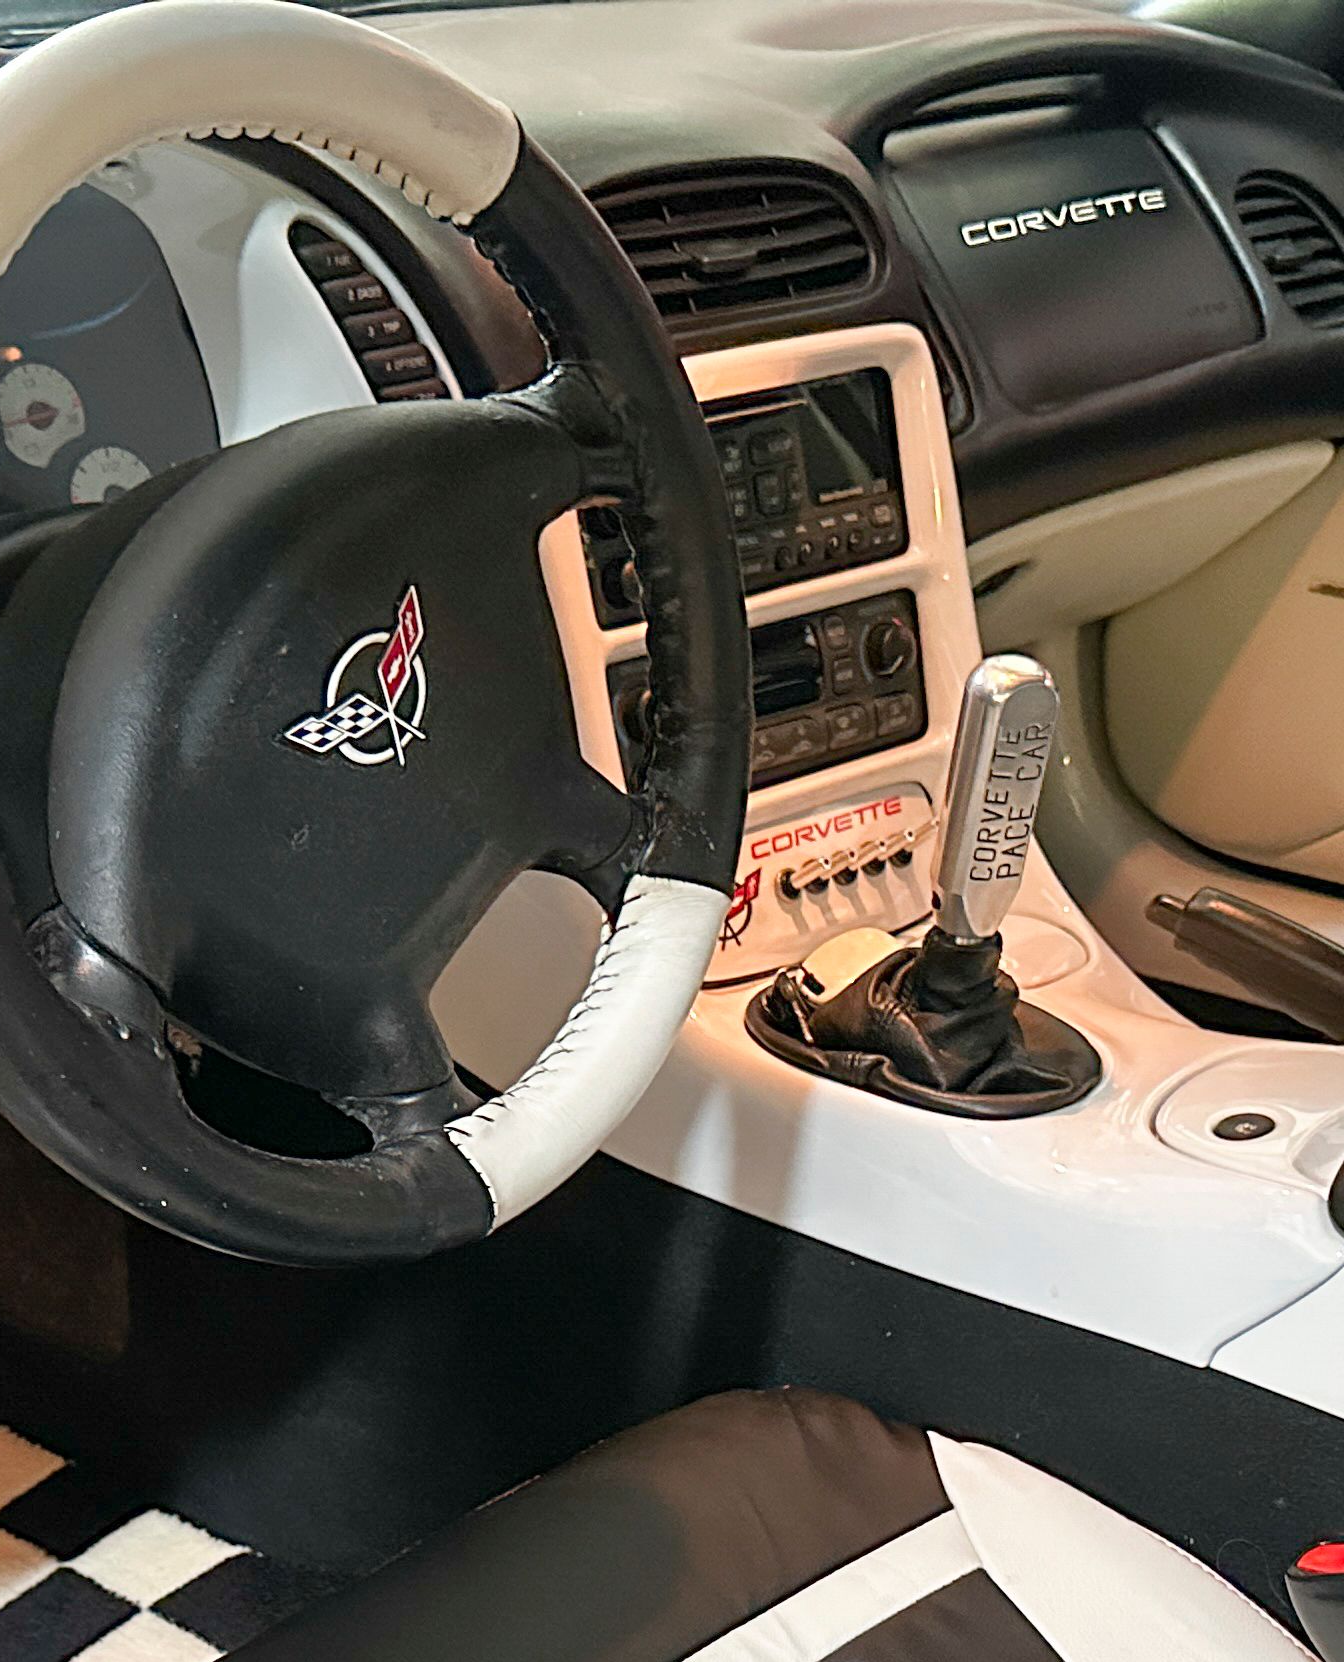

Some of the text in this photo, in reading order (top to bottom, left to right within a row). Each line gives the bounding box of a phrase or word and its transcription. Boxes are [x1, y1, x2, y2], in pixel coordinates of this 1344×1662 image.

[960, 187, 1167, 246] CORVETTE
[750, 796, 902, 861] CORVETTE
[969, 729, 1021, 883] CORVETTE
[995, 722, 1051, 881] PACE CAR
